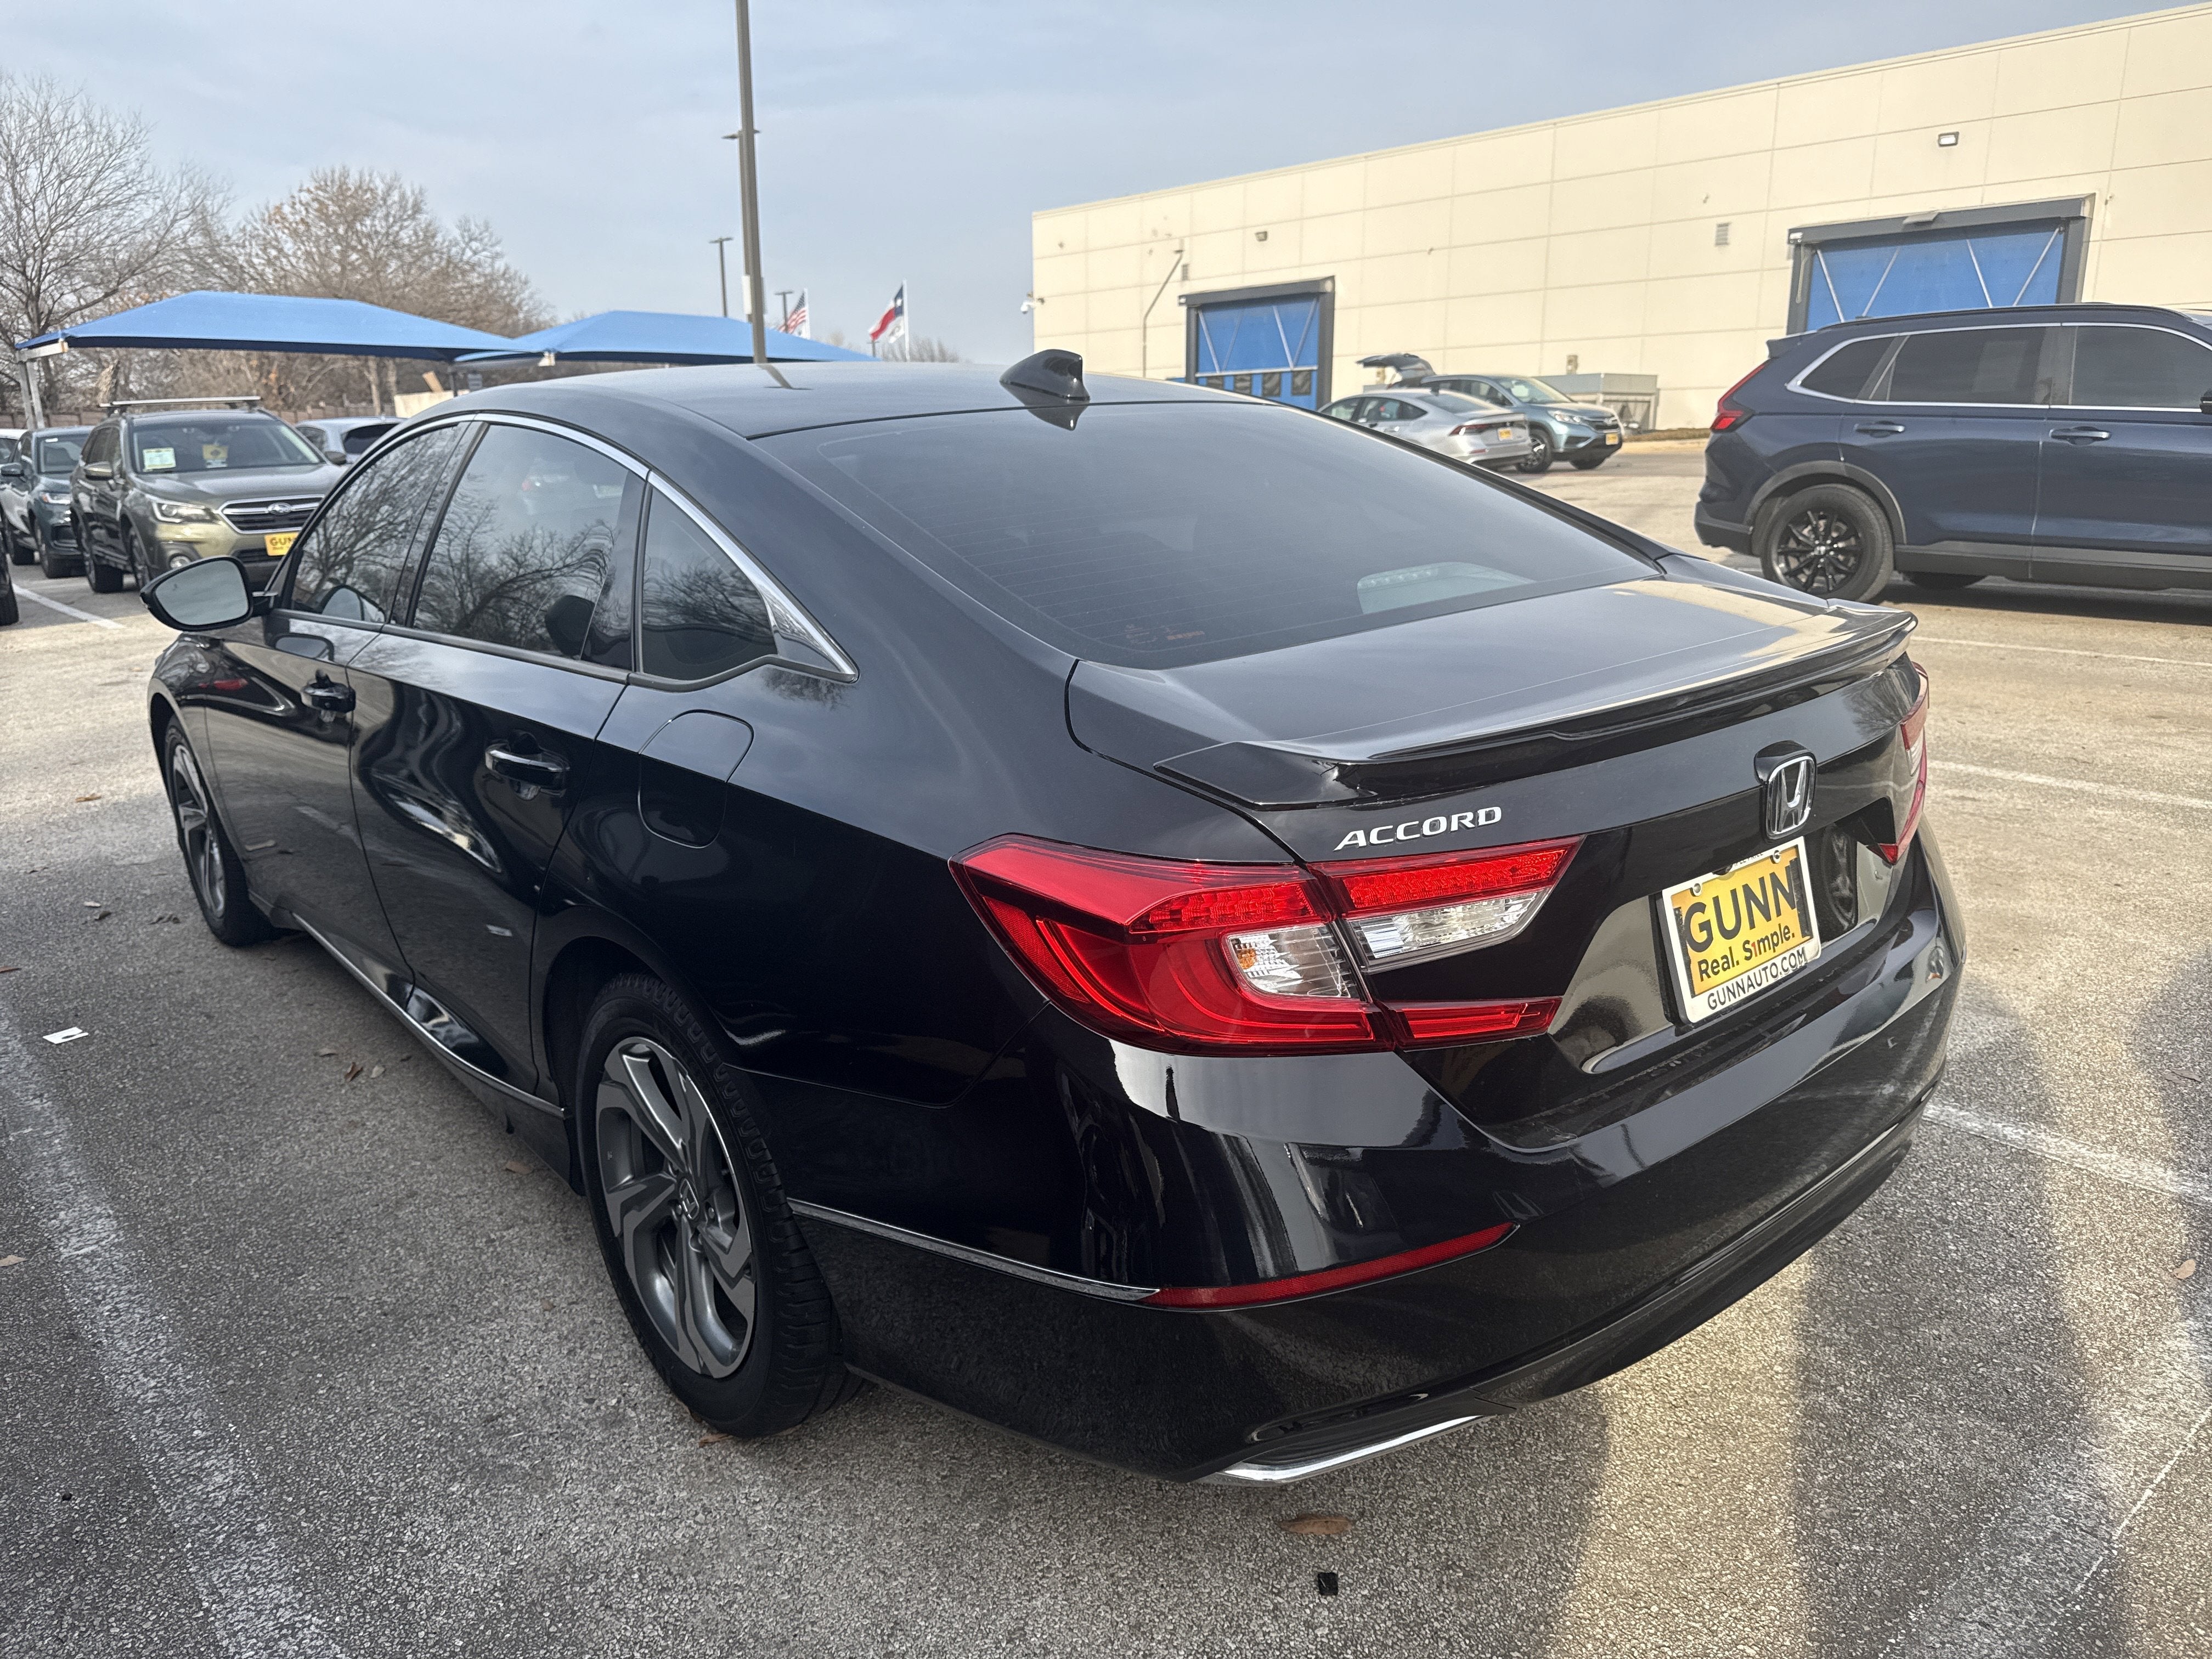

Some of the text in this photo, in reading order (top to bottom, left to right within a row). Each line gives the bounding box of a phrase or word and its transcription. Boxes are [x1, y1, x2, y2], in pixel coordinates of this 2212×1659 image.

[1333, 806, 1502, 851] ACCORD
[1684, 871, 1796, 953] GUNN
[1697, 946, 1740, 982] Real.
[1707, 946, 1808, 1010] GUNNAUTO.COM
